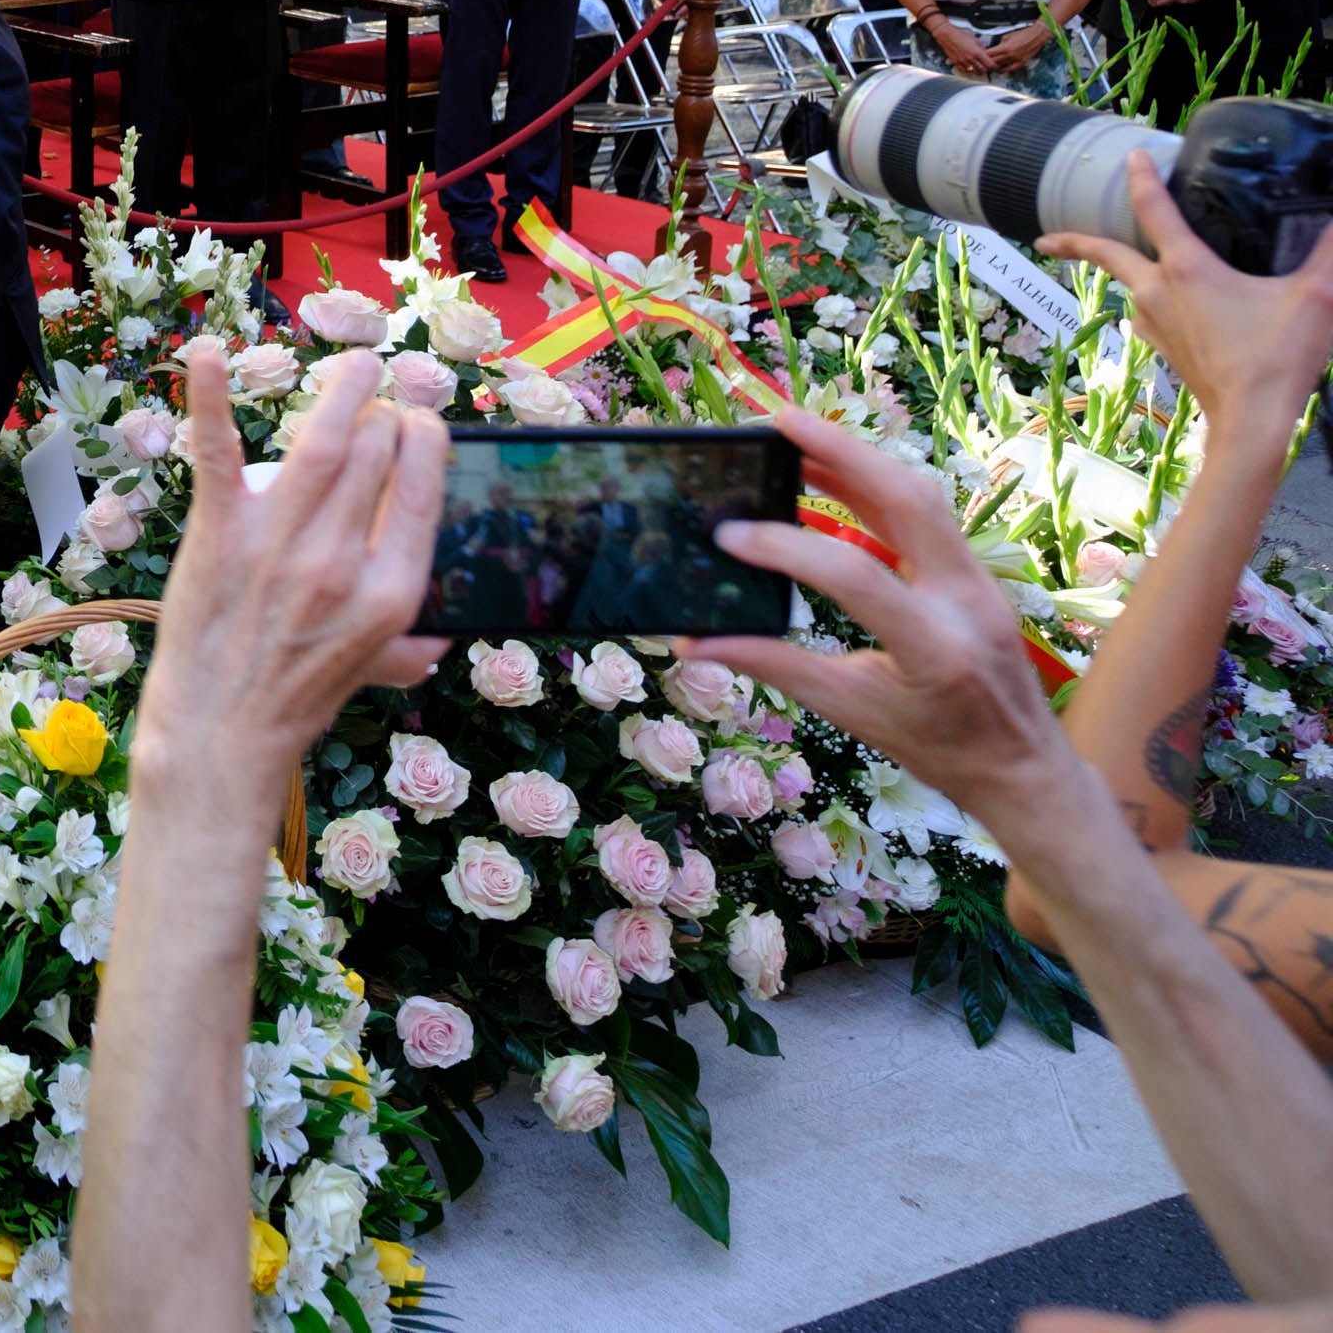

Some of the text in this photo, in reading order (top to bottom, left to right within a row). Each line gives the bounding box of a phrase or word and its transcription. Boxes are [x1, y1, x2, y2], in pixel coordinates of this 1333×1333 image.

[965, 235, 987, 257] DE
[987, 254, 1010, 276] LA
[1012, 276, 1081, 333] ALHAMB
[1102, 346, 1117, 359] Y
